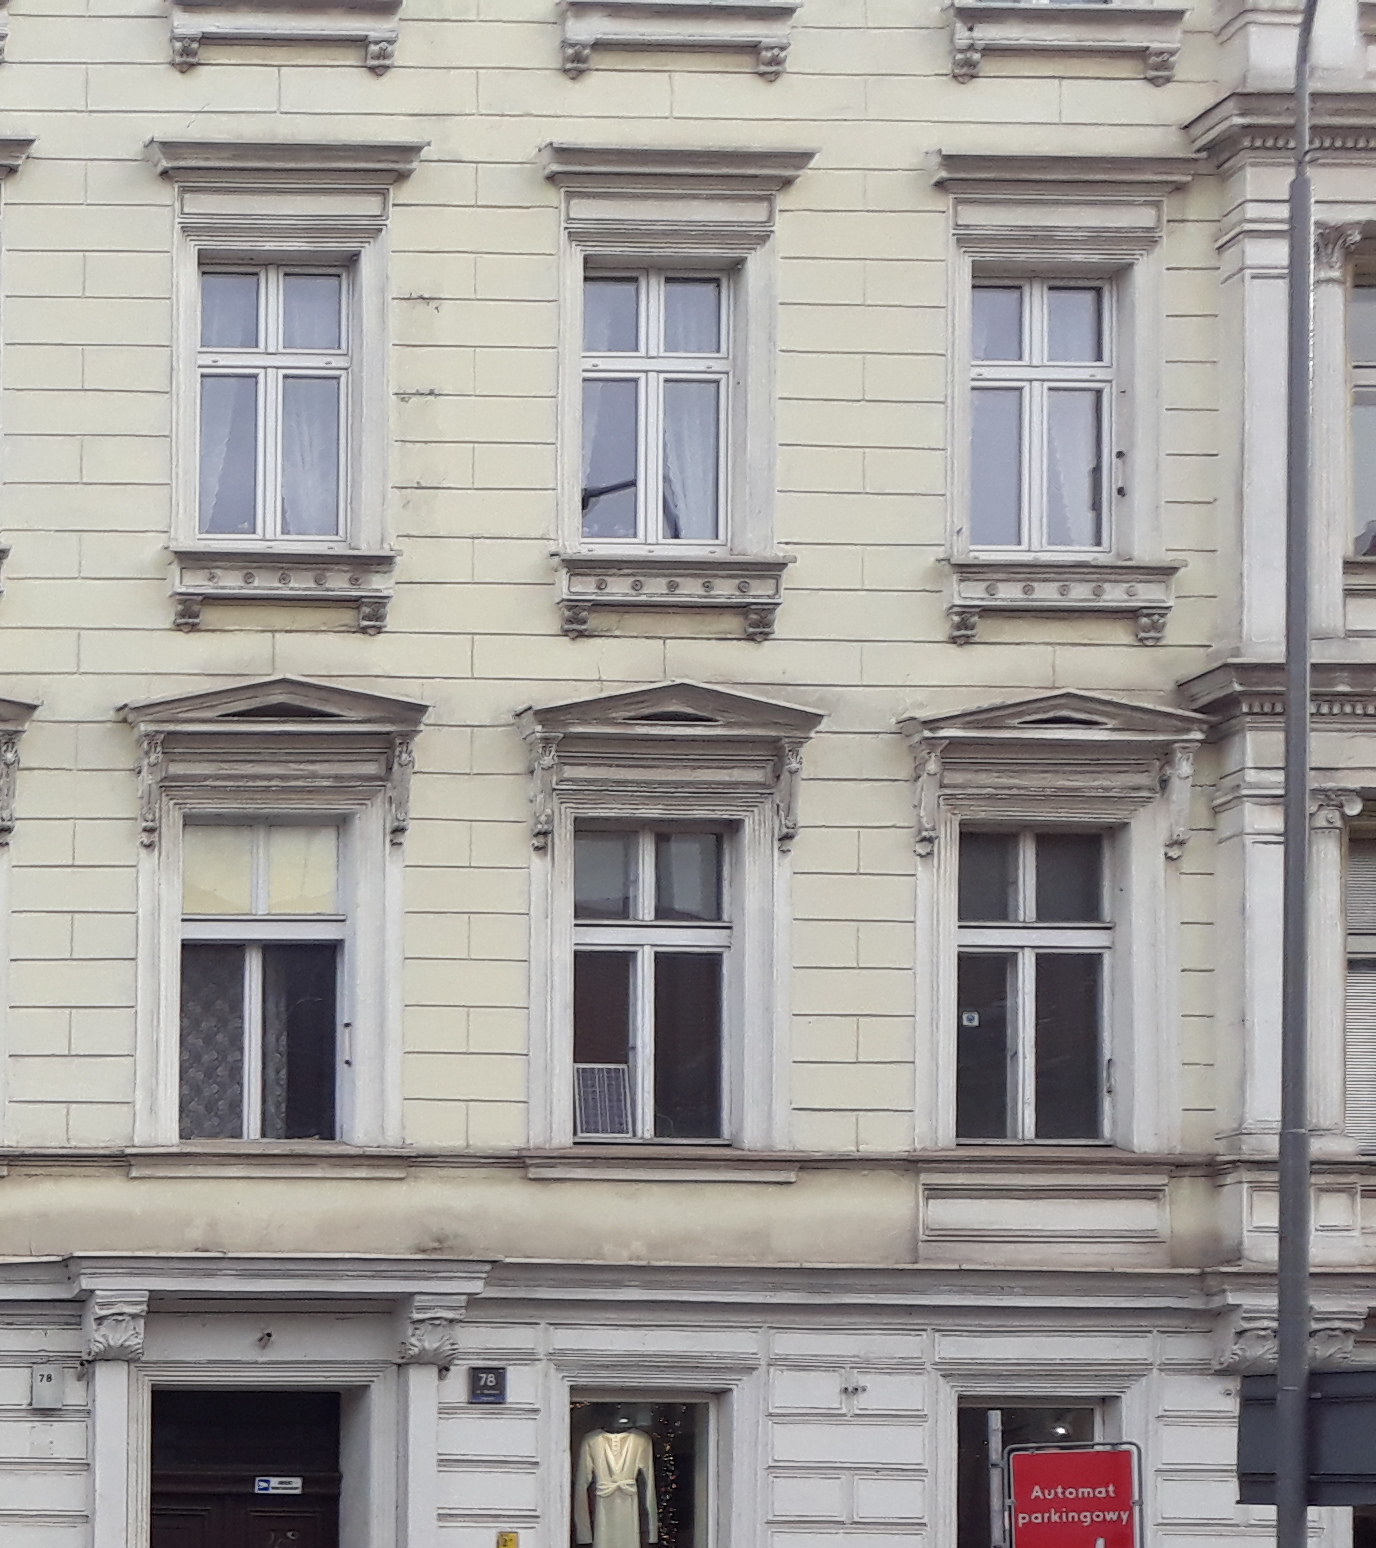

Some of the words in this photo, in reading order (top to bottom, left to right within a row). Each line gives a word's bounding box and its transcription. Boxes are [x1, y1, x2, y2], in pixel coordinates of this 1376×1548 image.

[38, 1373, 53, 1383] 78
[477, 1373, 497, 1386] 78
[1030, 1484, 1116, 1500] Automat
[1018, 1508, 1130, 1527] parkingowy
